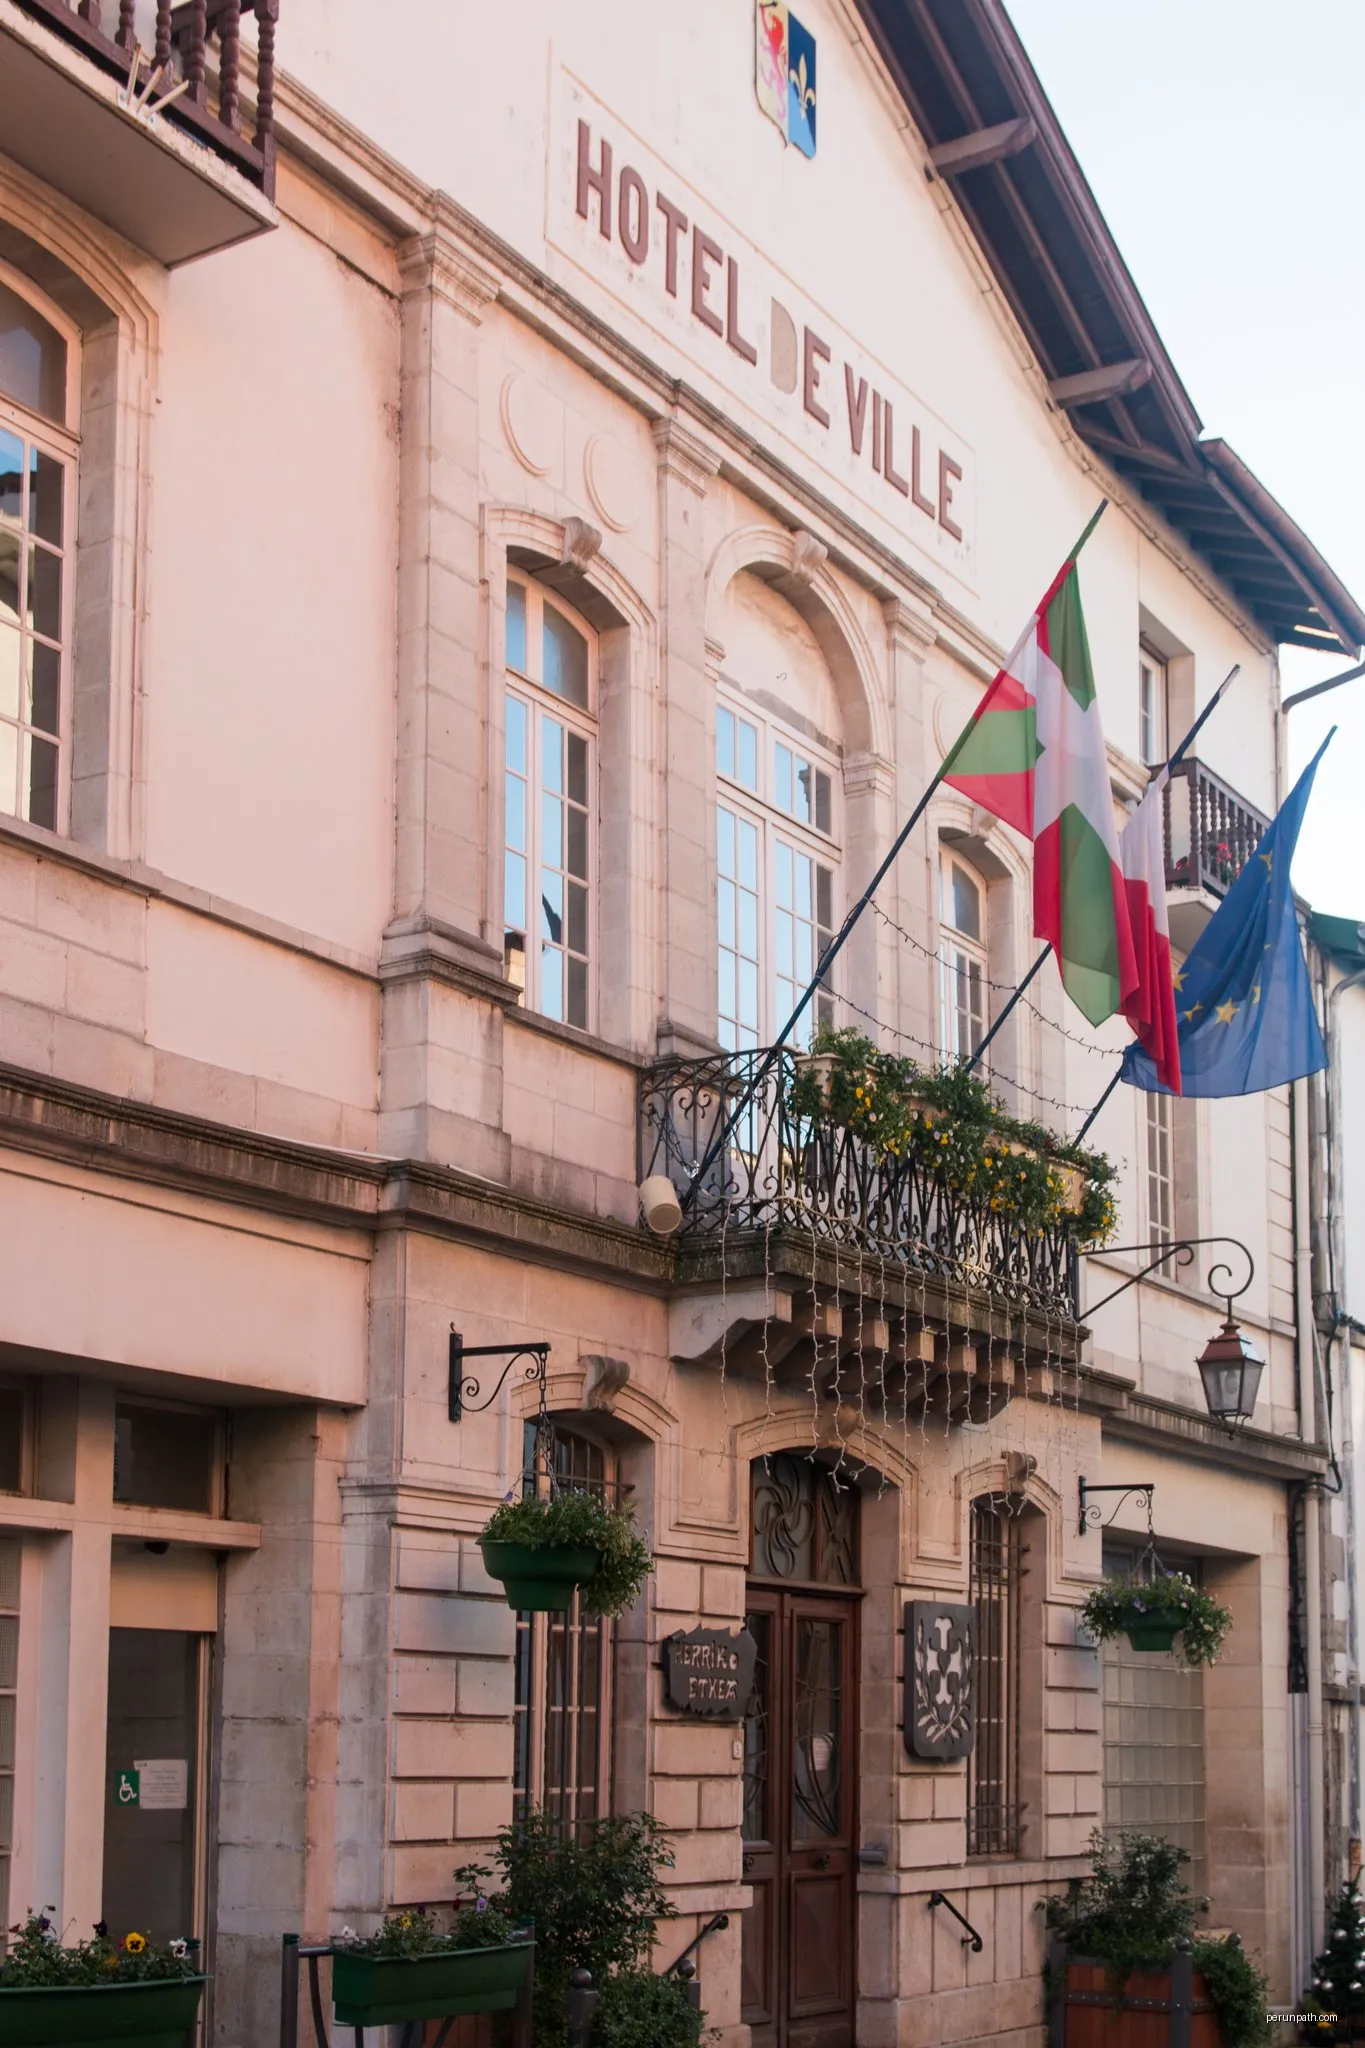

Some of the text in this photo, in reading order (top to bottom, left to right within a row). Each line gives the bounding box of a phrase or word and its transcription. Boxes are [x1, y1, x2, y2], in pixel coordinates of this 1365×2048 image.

[576, 118, 757, 367] HOTEL
[844, 361, 963, 543] VILLE
[689, 1676, 738, 1700] ETXEA
